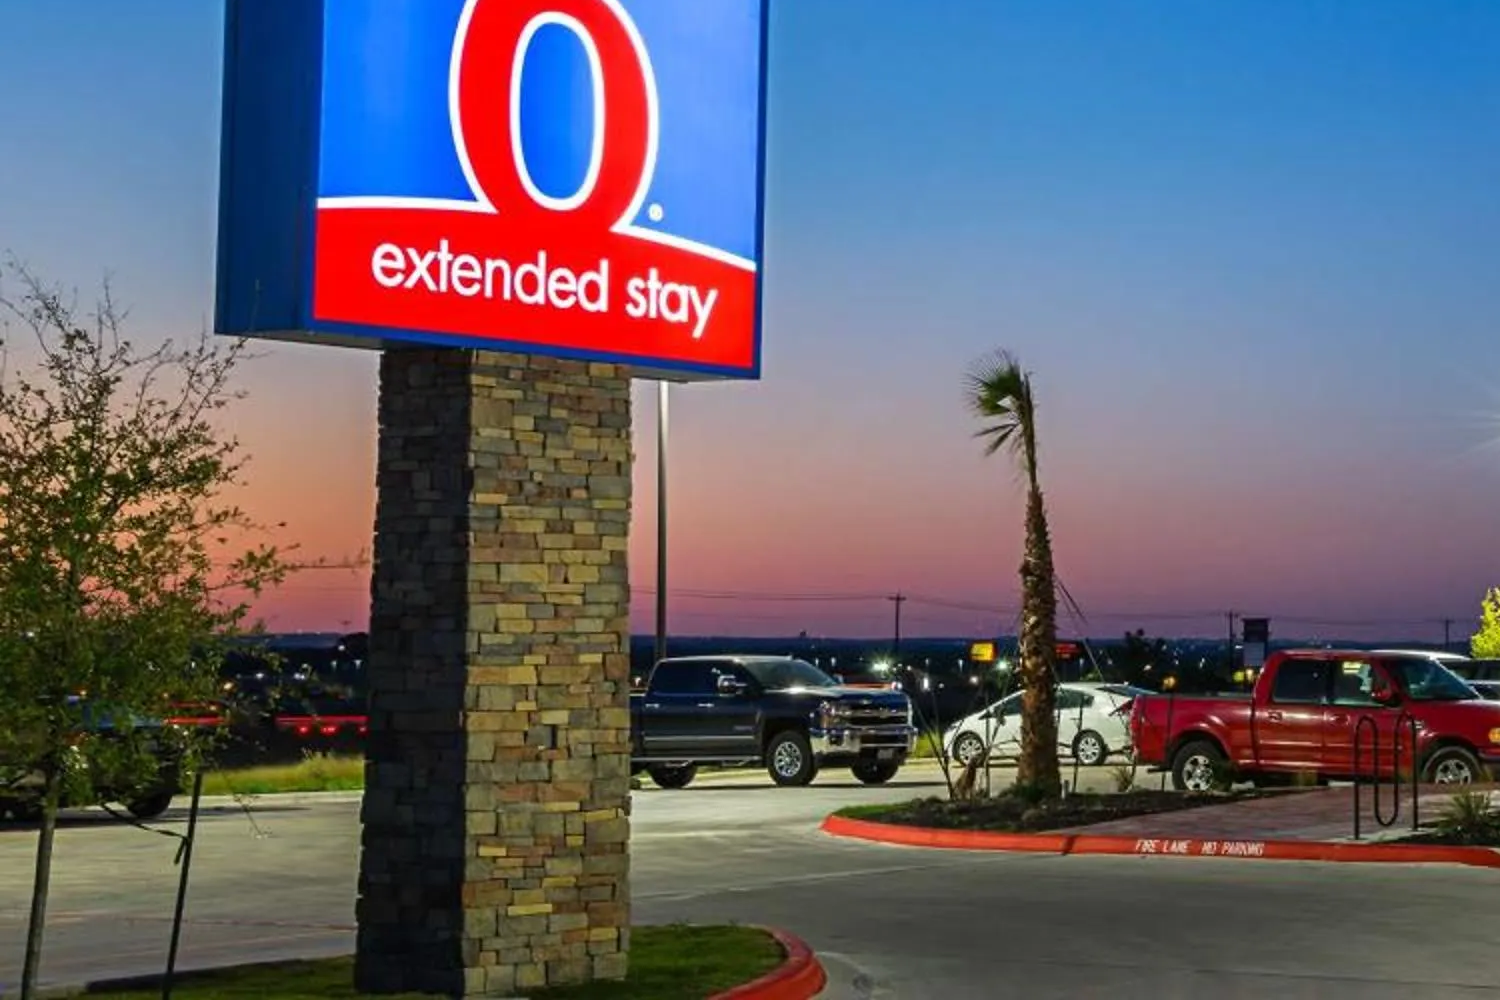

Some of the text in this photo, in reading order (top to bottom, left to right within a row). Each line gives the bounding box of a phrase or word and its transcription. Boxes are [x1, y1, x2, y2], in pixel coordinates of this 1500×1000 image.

[371, 238, 718, 338] extended stay
[1135, 839, 1265, 856] FIRE LANE NO PARKING
